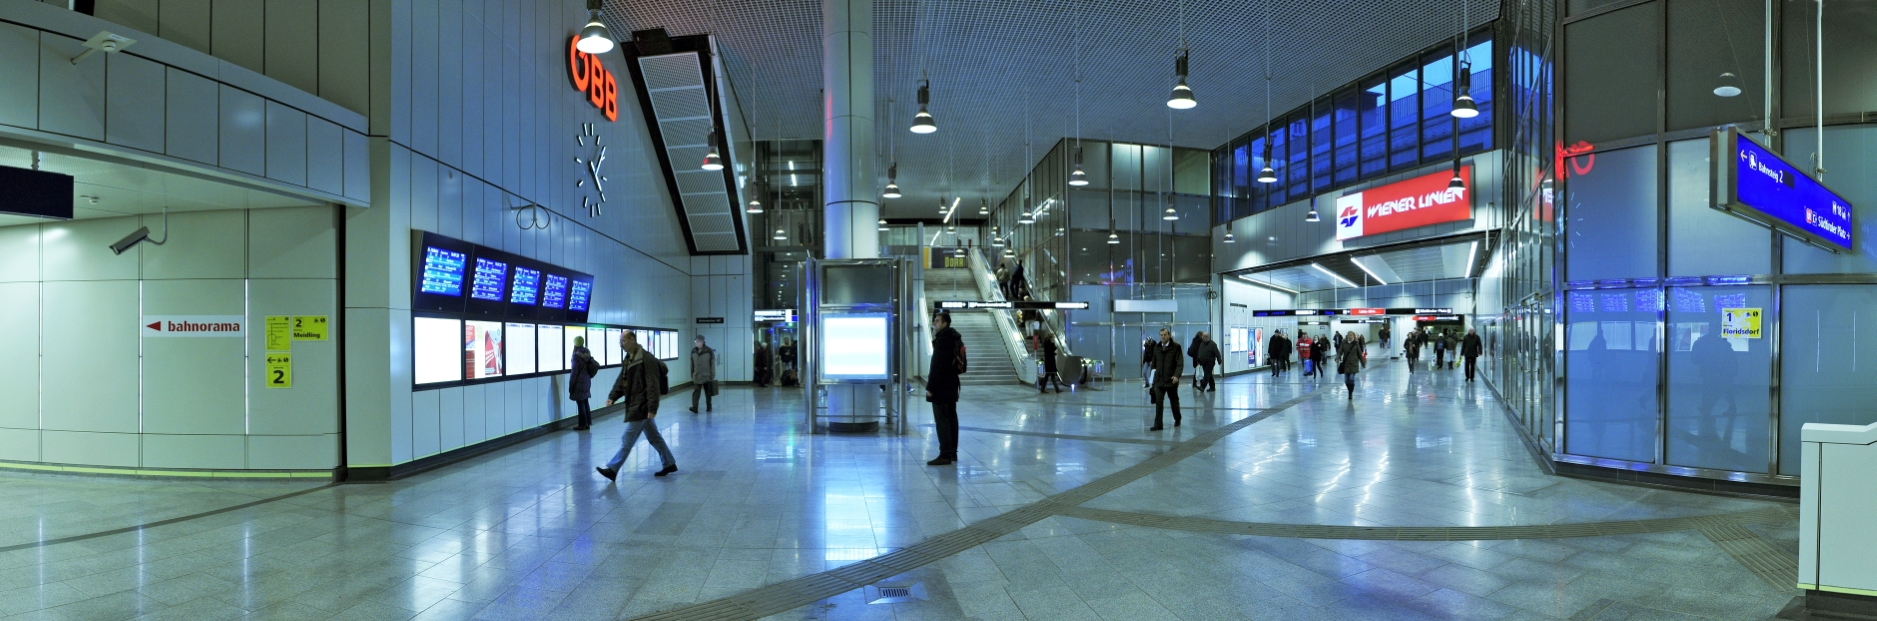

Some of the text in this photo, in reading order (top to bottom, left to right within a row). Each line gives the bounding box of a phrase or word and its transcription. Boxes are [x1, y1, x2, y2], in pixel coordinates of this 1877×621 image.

[1758, 160, 1784, 184] Bahnsteig 2
[1367, 188, 1464, 219] WIENER LINIEN
[1818, 215, 1838, 235] Südtiroler
[1837, 225, 1847, 239] Platz
[295, 318, 303, 328] 2
[1726, 312, 1732, 322] 1
[168, 320, 240, 332] bahnorama
[273, 369, 285, 384] 2
